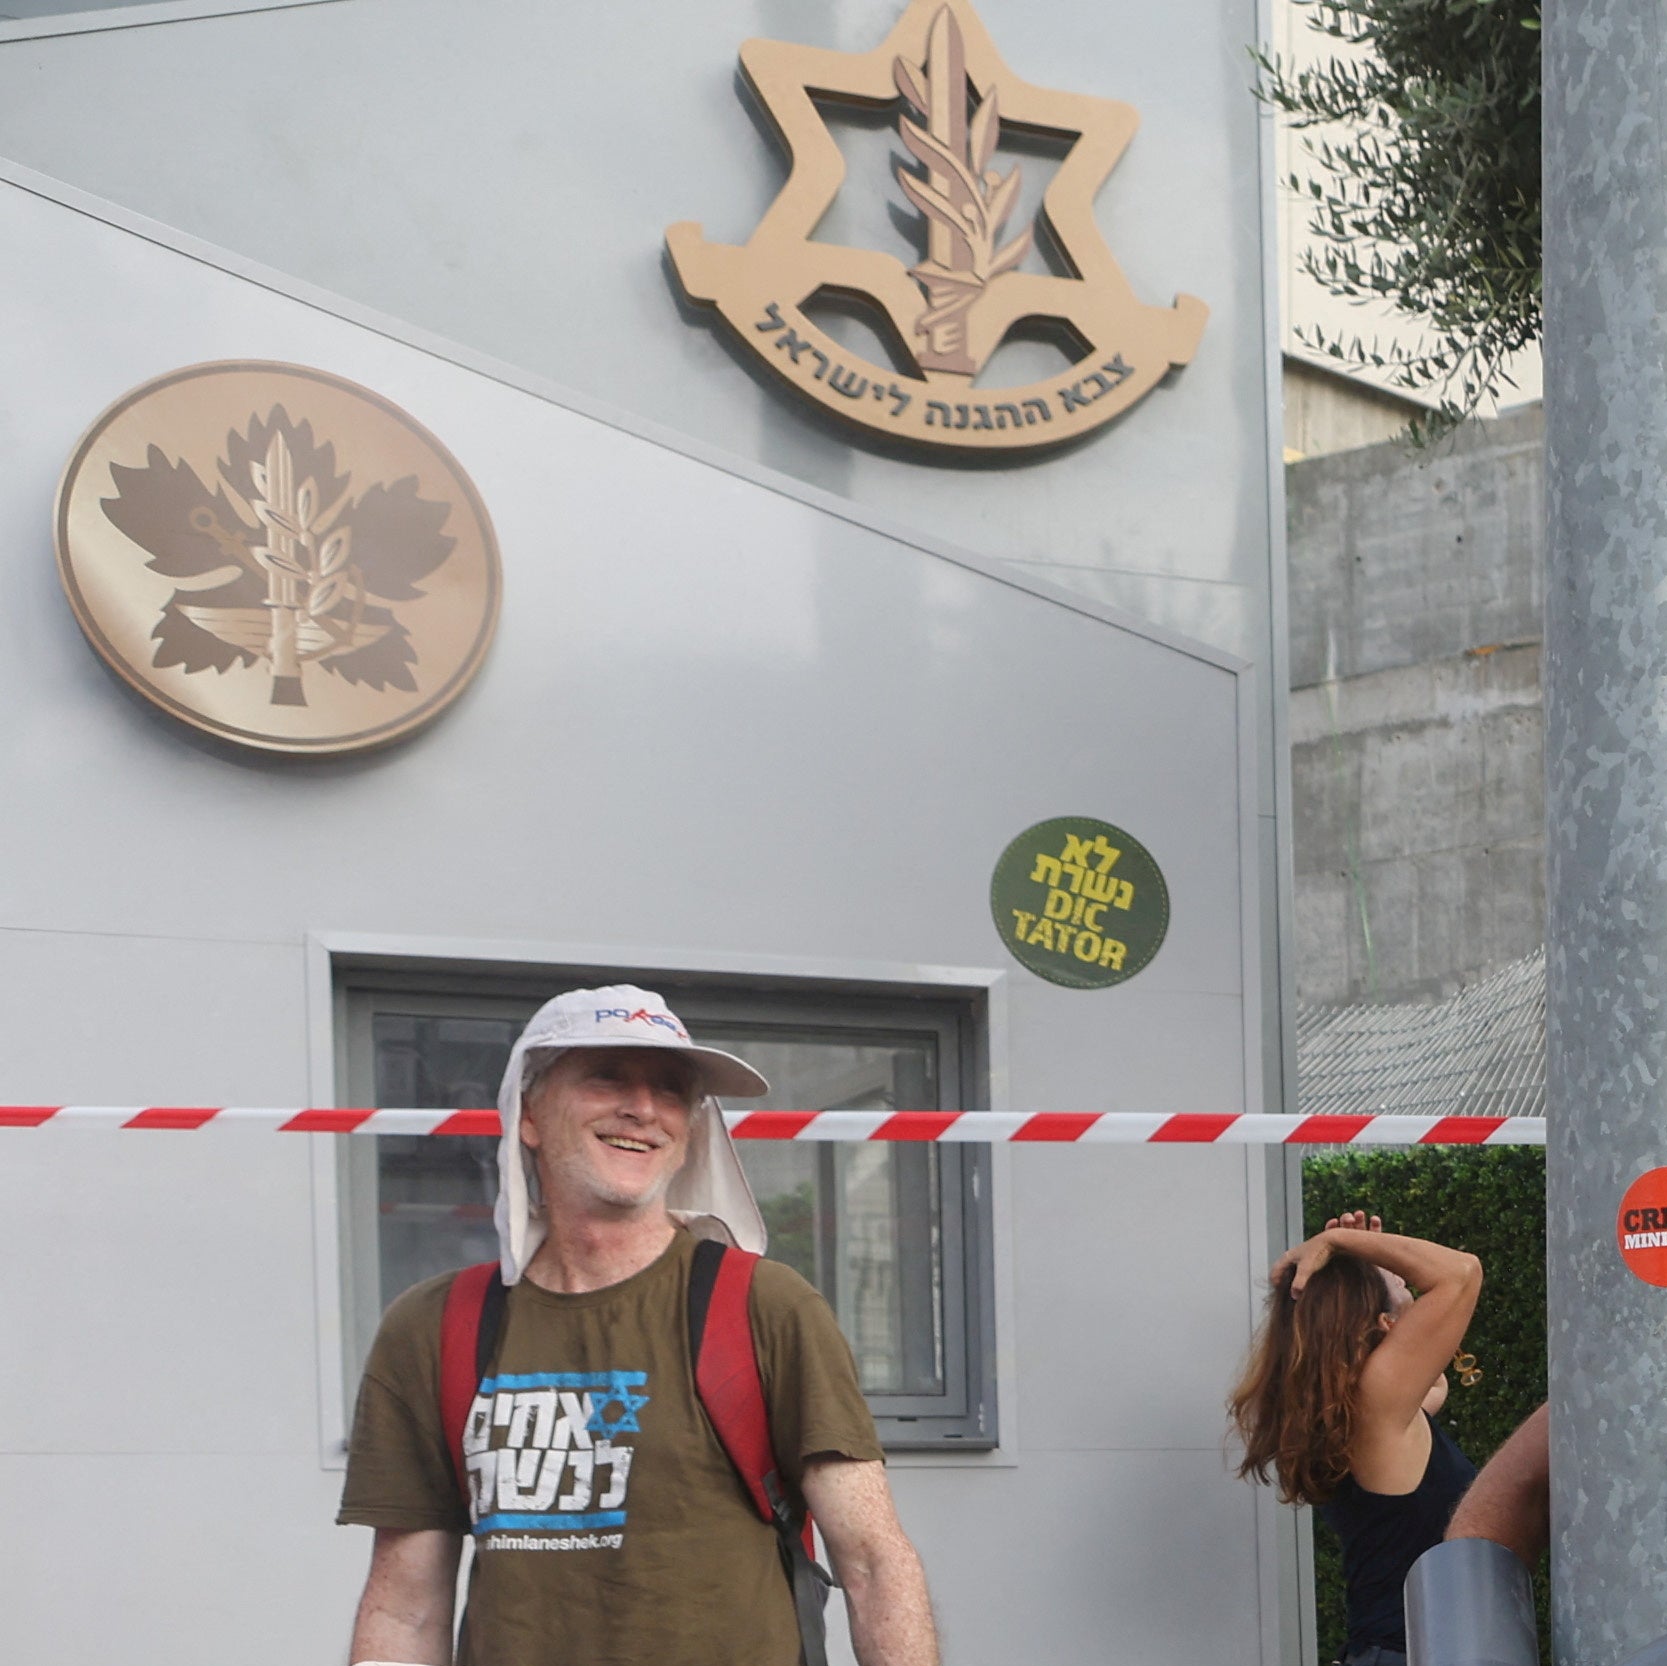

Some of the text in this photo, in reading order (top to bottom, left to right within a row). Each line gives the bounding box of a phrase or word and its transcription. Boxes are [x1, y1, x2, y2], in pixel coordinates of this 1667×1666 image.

[755, 302, 1135, 430] צבא ההגנה לישראל
[1030, 853, 1135, 910] נשרת
[1060, 832, 1121, 875] לא
[1012, 908, 1127, 971] TATOR
[462, 1386, 594, 1457] אחים
[465, 1439, 635, 1526] לנשק
